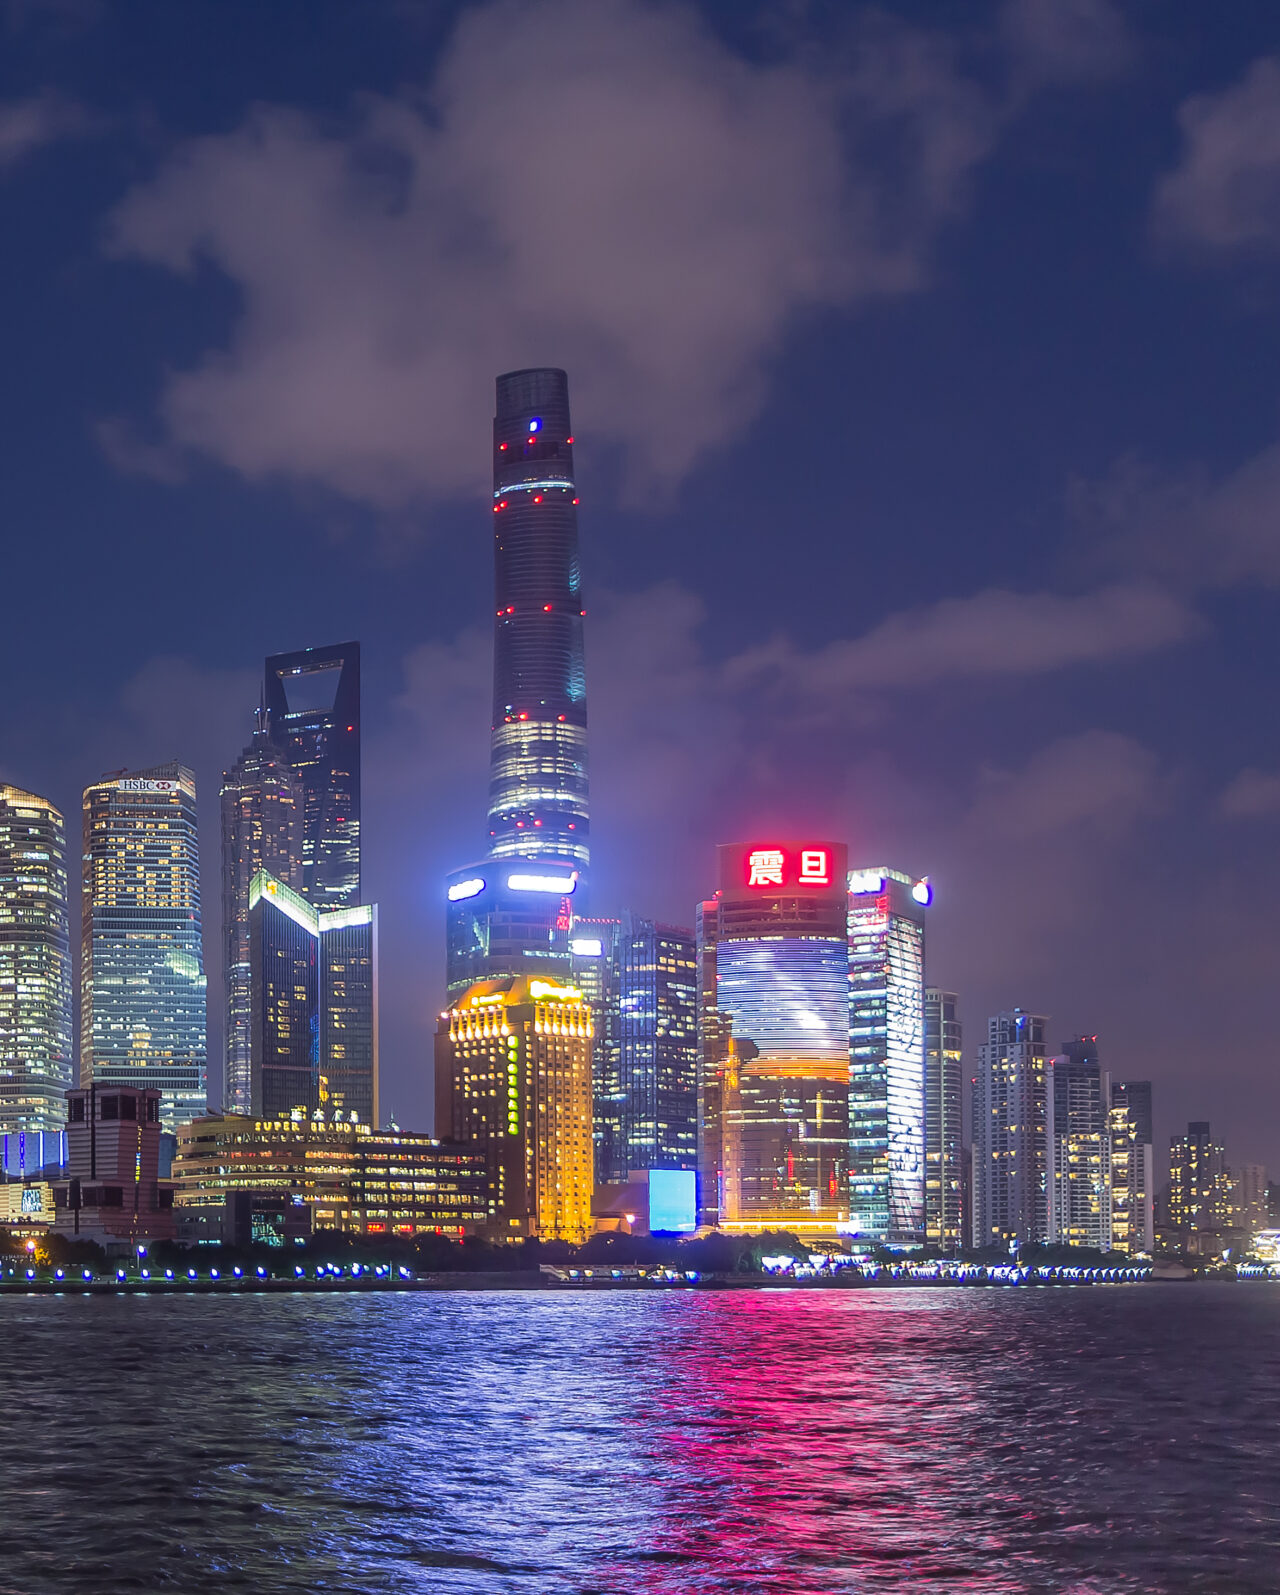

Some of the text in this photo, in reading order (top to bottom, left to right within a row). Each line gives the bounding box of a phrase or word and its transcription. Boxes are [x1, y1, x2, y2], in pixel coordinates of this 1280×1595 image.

[124, 780, 155, 790] HSBC
[748, 850, 829, 886] 震旦
[254, 1121, 300, 1132] SUPER
[310, 1121, 351, 1134] BRAND
